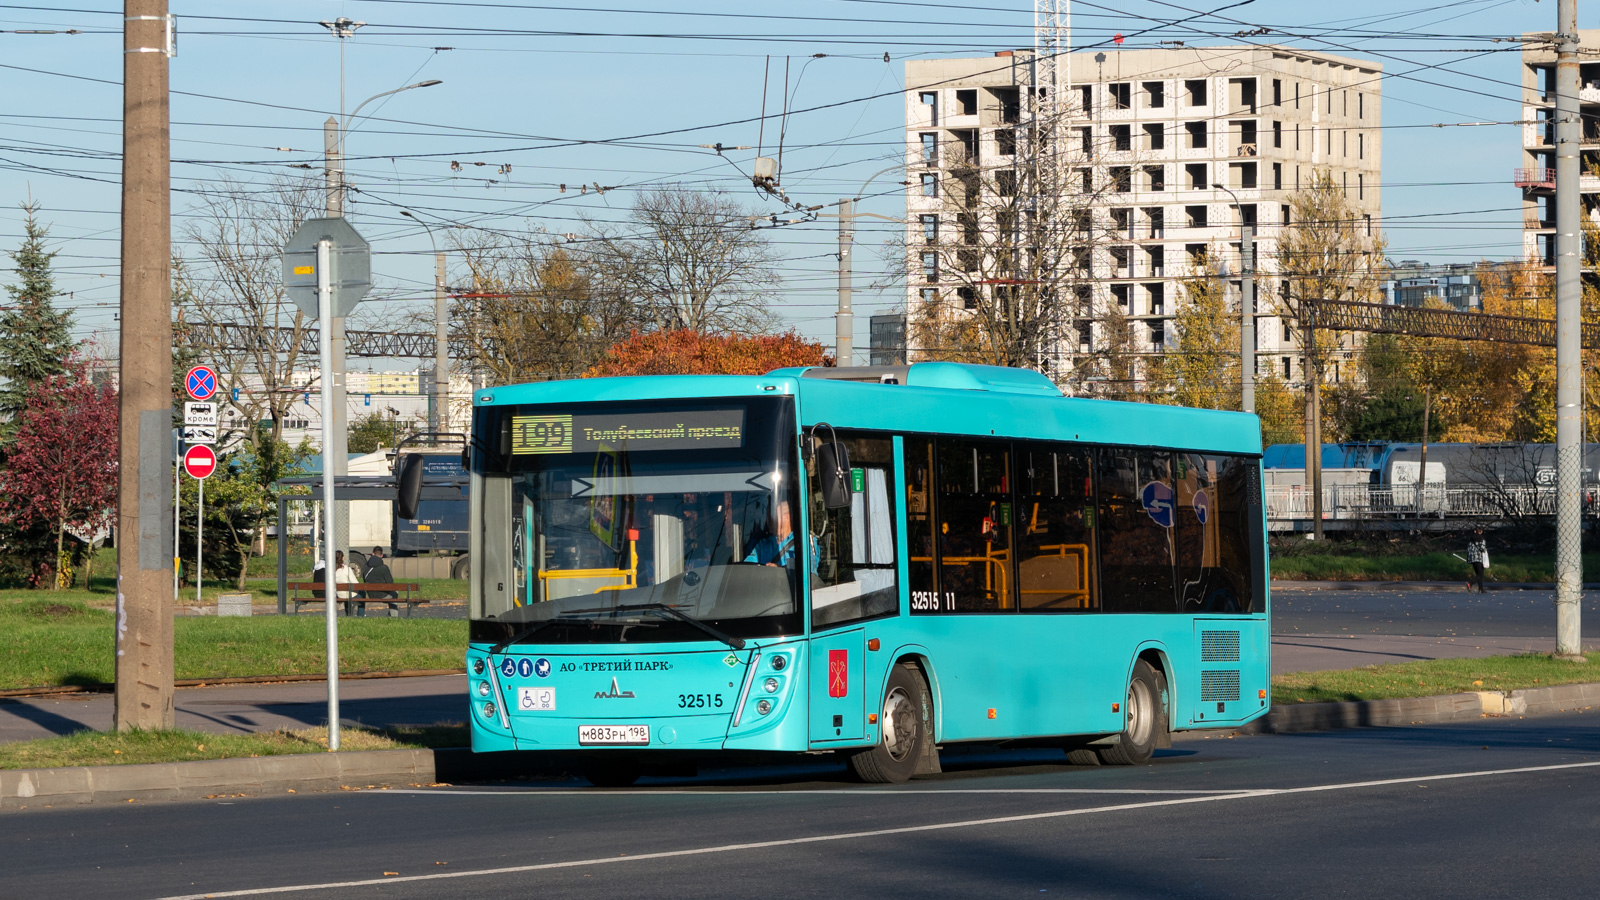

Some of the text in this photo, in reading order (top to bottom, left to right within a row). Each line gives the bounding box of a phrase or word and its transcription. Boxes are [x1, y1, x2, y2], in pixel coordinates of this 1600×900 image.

[517, 420, 567, 448] 199
[688, 426, 741, 440] проезд
[497, 582, 504, 592] 6
[911, 591, 956, 611] 32515 11
[559, 659, 674, 672] АО «ТРЕТИЙ ПАРК»
[678, 693, 723, 708] 32515
[581, 728, 627, 741] М883РН
[628, 727, 647, 737] 198
